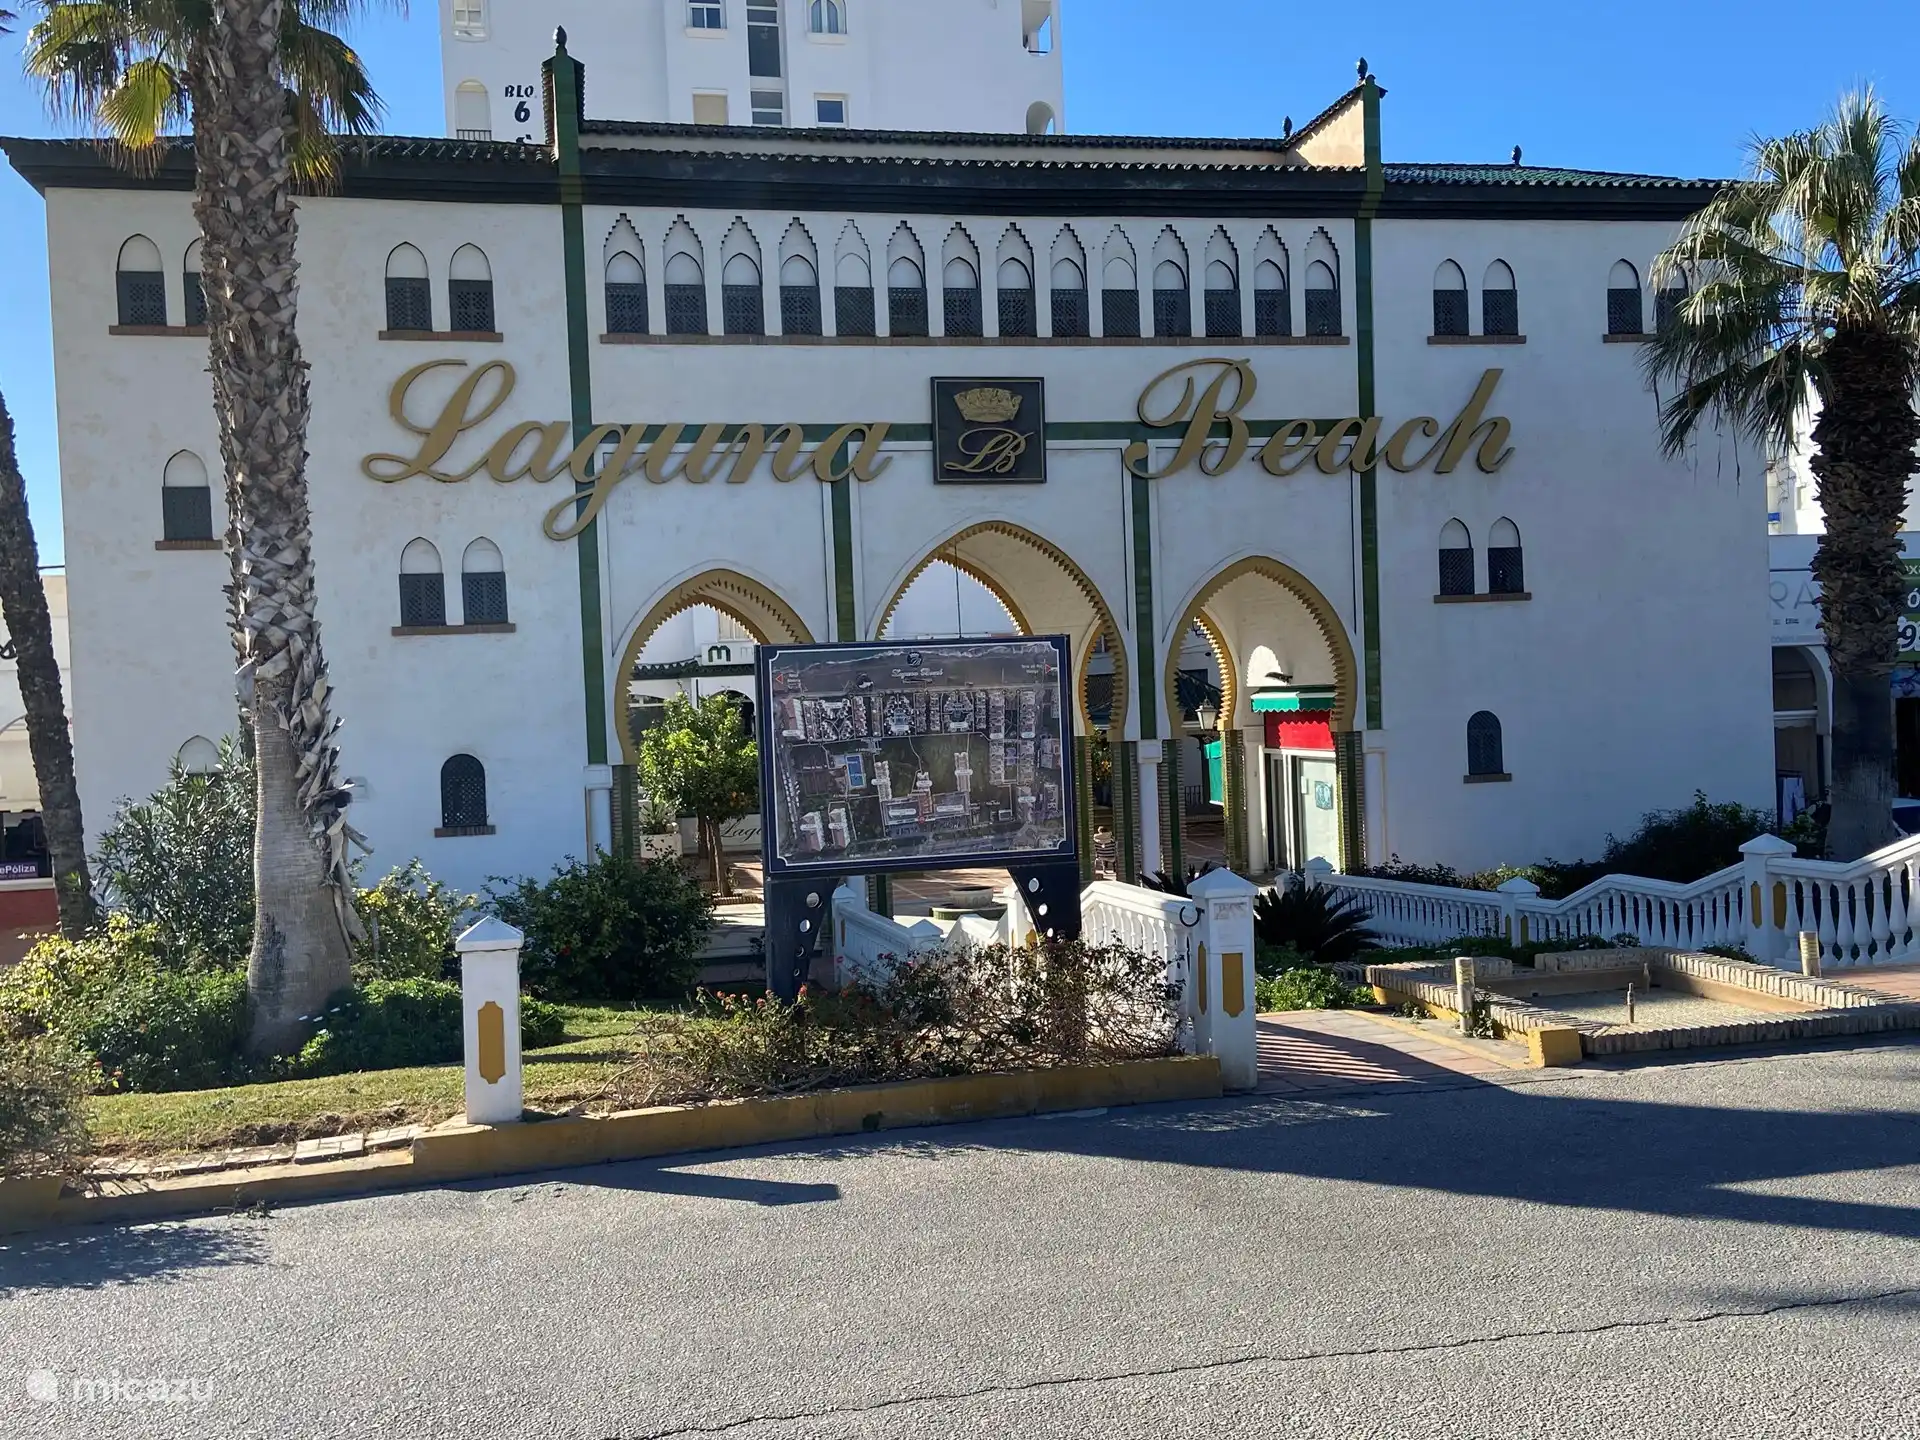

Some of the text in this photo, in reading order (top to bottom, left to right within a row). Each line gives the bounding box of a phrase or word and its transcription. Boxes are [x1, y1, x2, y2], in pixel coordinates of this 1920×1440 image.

[514, 100, 531, 123] 6
[361, 357, 1516, 541] Laguna Beach
